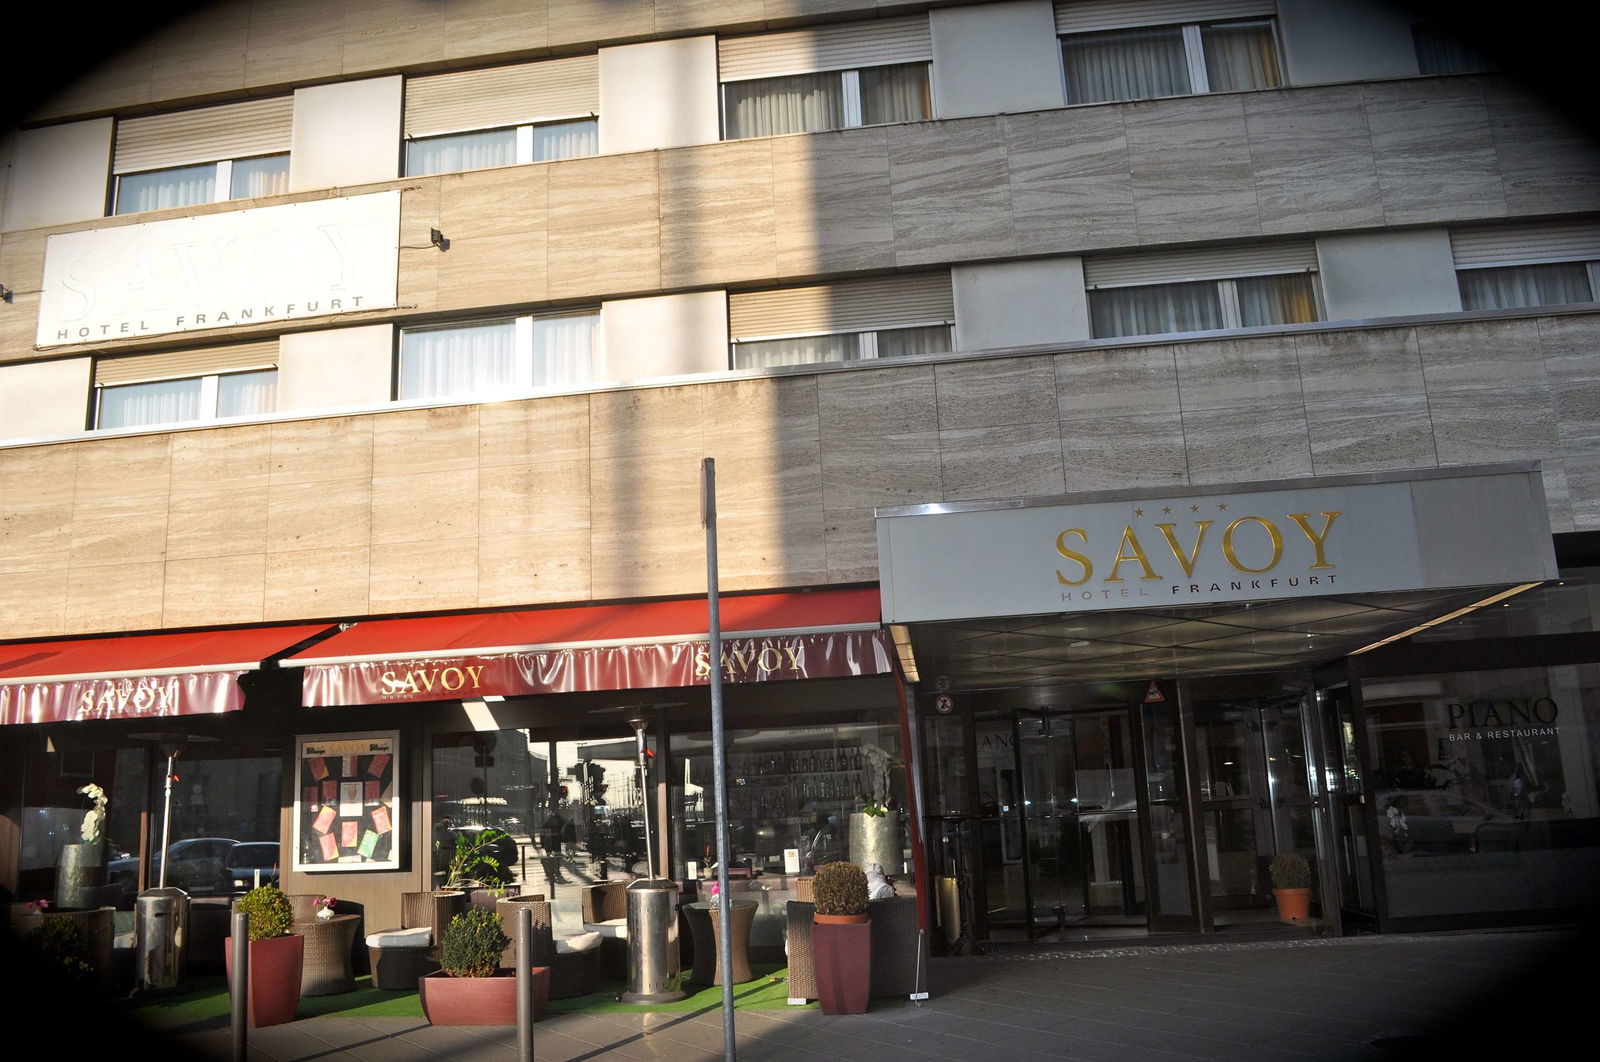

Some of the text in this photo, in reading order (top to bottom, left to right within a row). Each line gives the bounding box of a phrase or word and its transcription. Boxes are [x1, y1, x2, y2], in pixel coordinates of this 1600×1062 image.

[57, 219, 384, 322] SAVOY
[57, 296, 364, 340] HOTEL FRANKFURT
[1055, 511, 1344, 587] SAVOY
[1061, 575, 1338, 602] HOTEL FRANKFURT
[694, 645, 805, 677] SAVOY
[380, 665, 484, 695] SAVOY
[80, 686, 177, 713] SAVOY
[1446, 697, 1558, 729] PIANO
[1448, 727, 1561, 742] BAR & RESTAURANT
